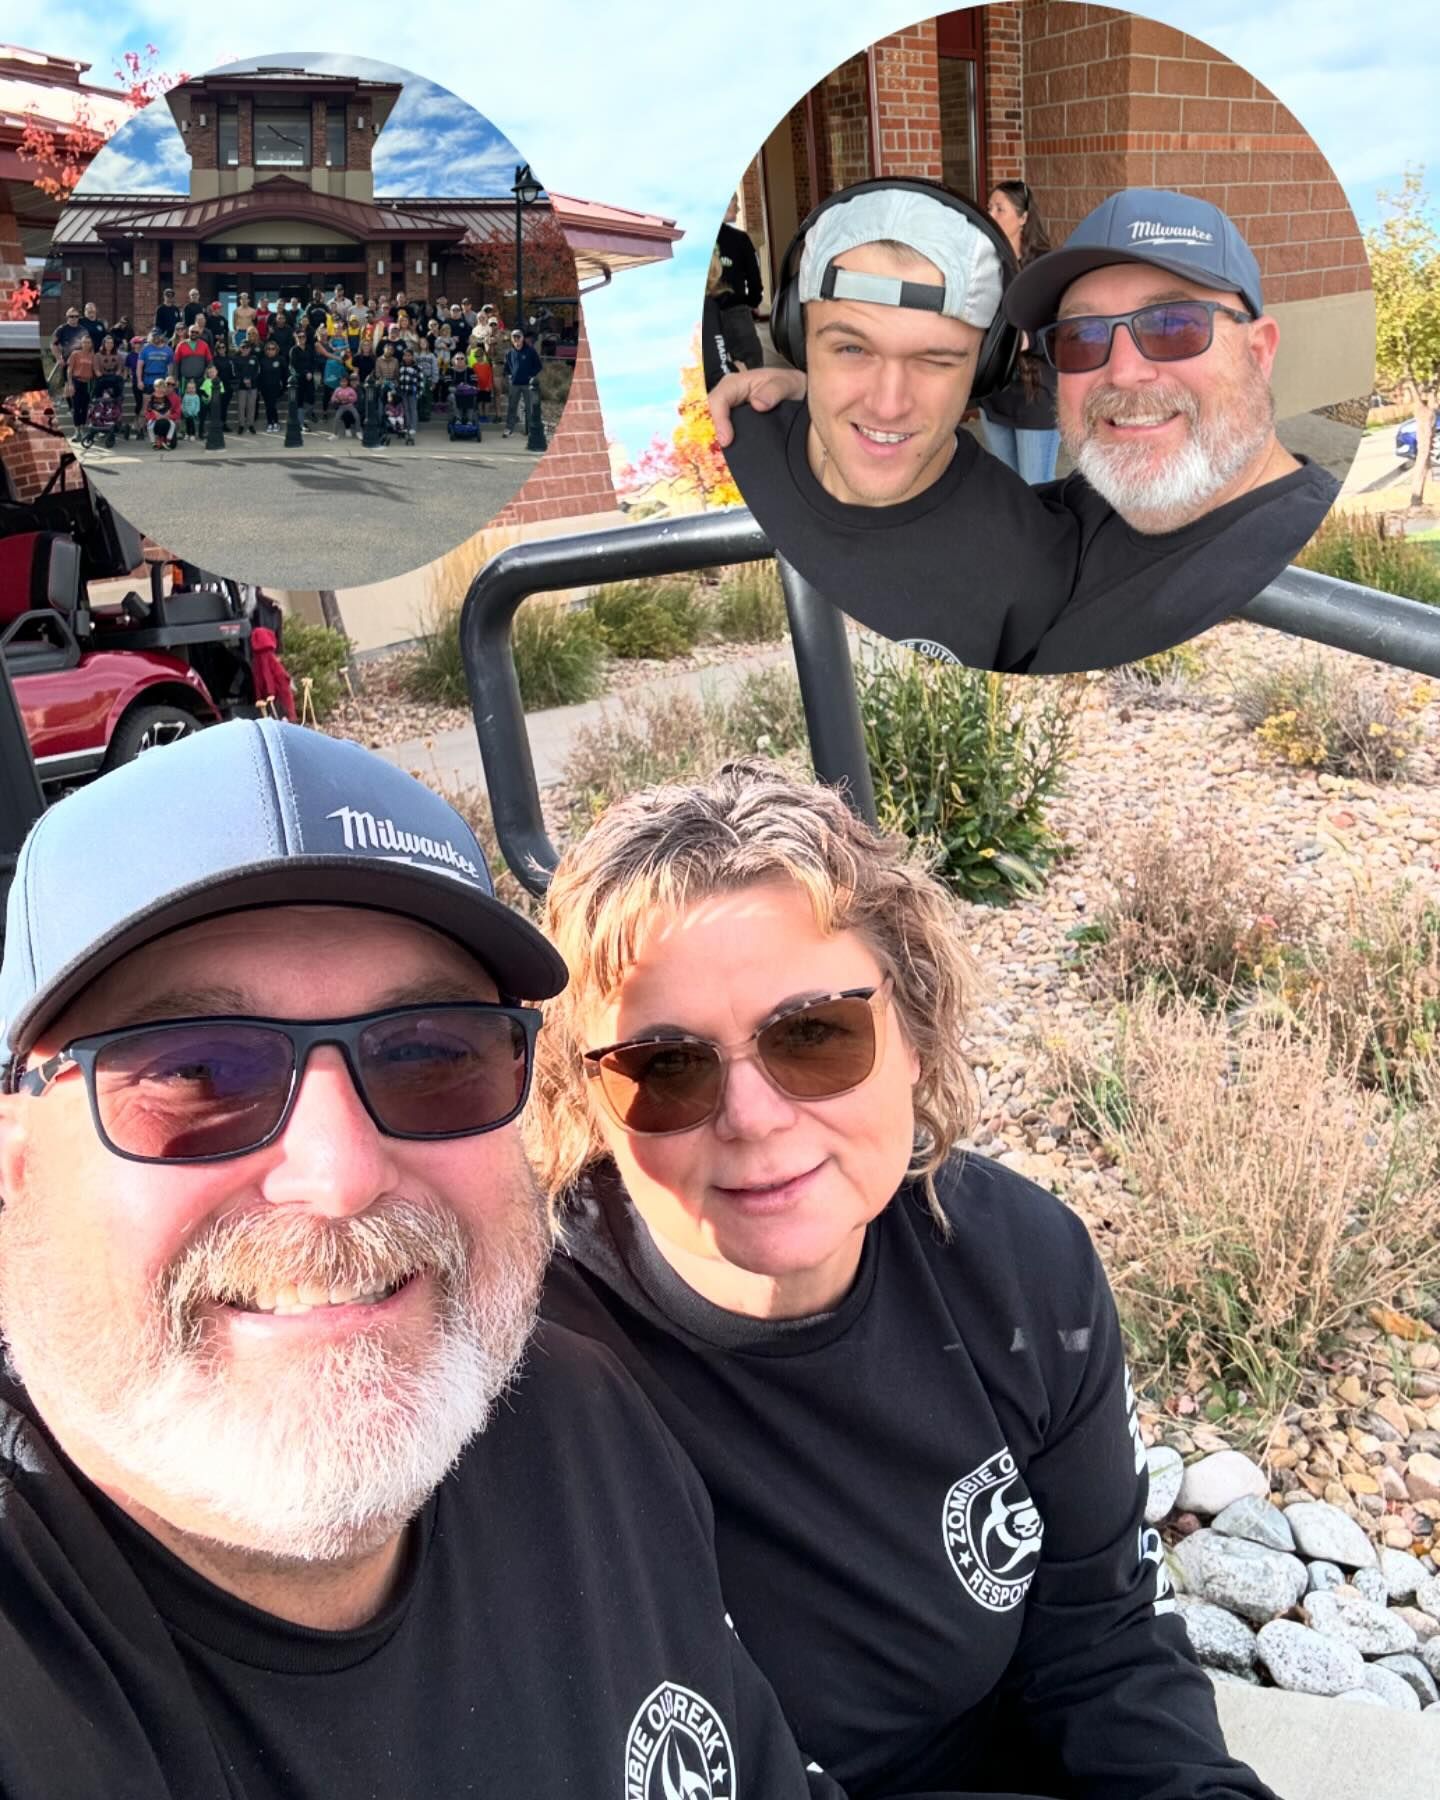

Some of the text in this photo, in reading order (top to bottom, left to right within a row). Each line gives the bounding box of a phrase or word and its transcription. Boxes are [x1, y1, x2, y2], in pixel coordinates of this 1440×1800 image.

[1126, 220, 1214, 241] Milwaukee
[325, 805, 480, 879] Milwaukee
[947, 1467, 997, 1547] ZOMBIE
[968, 1568, 1032, 1606] RESPON
[628, 1726, 654, 1800] MBIE
